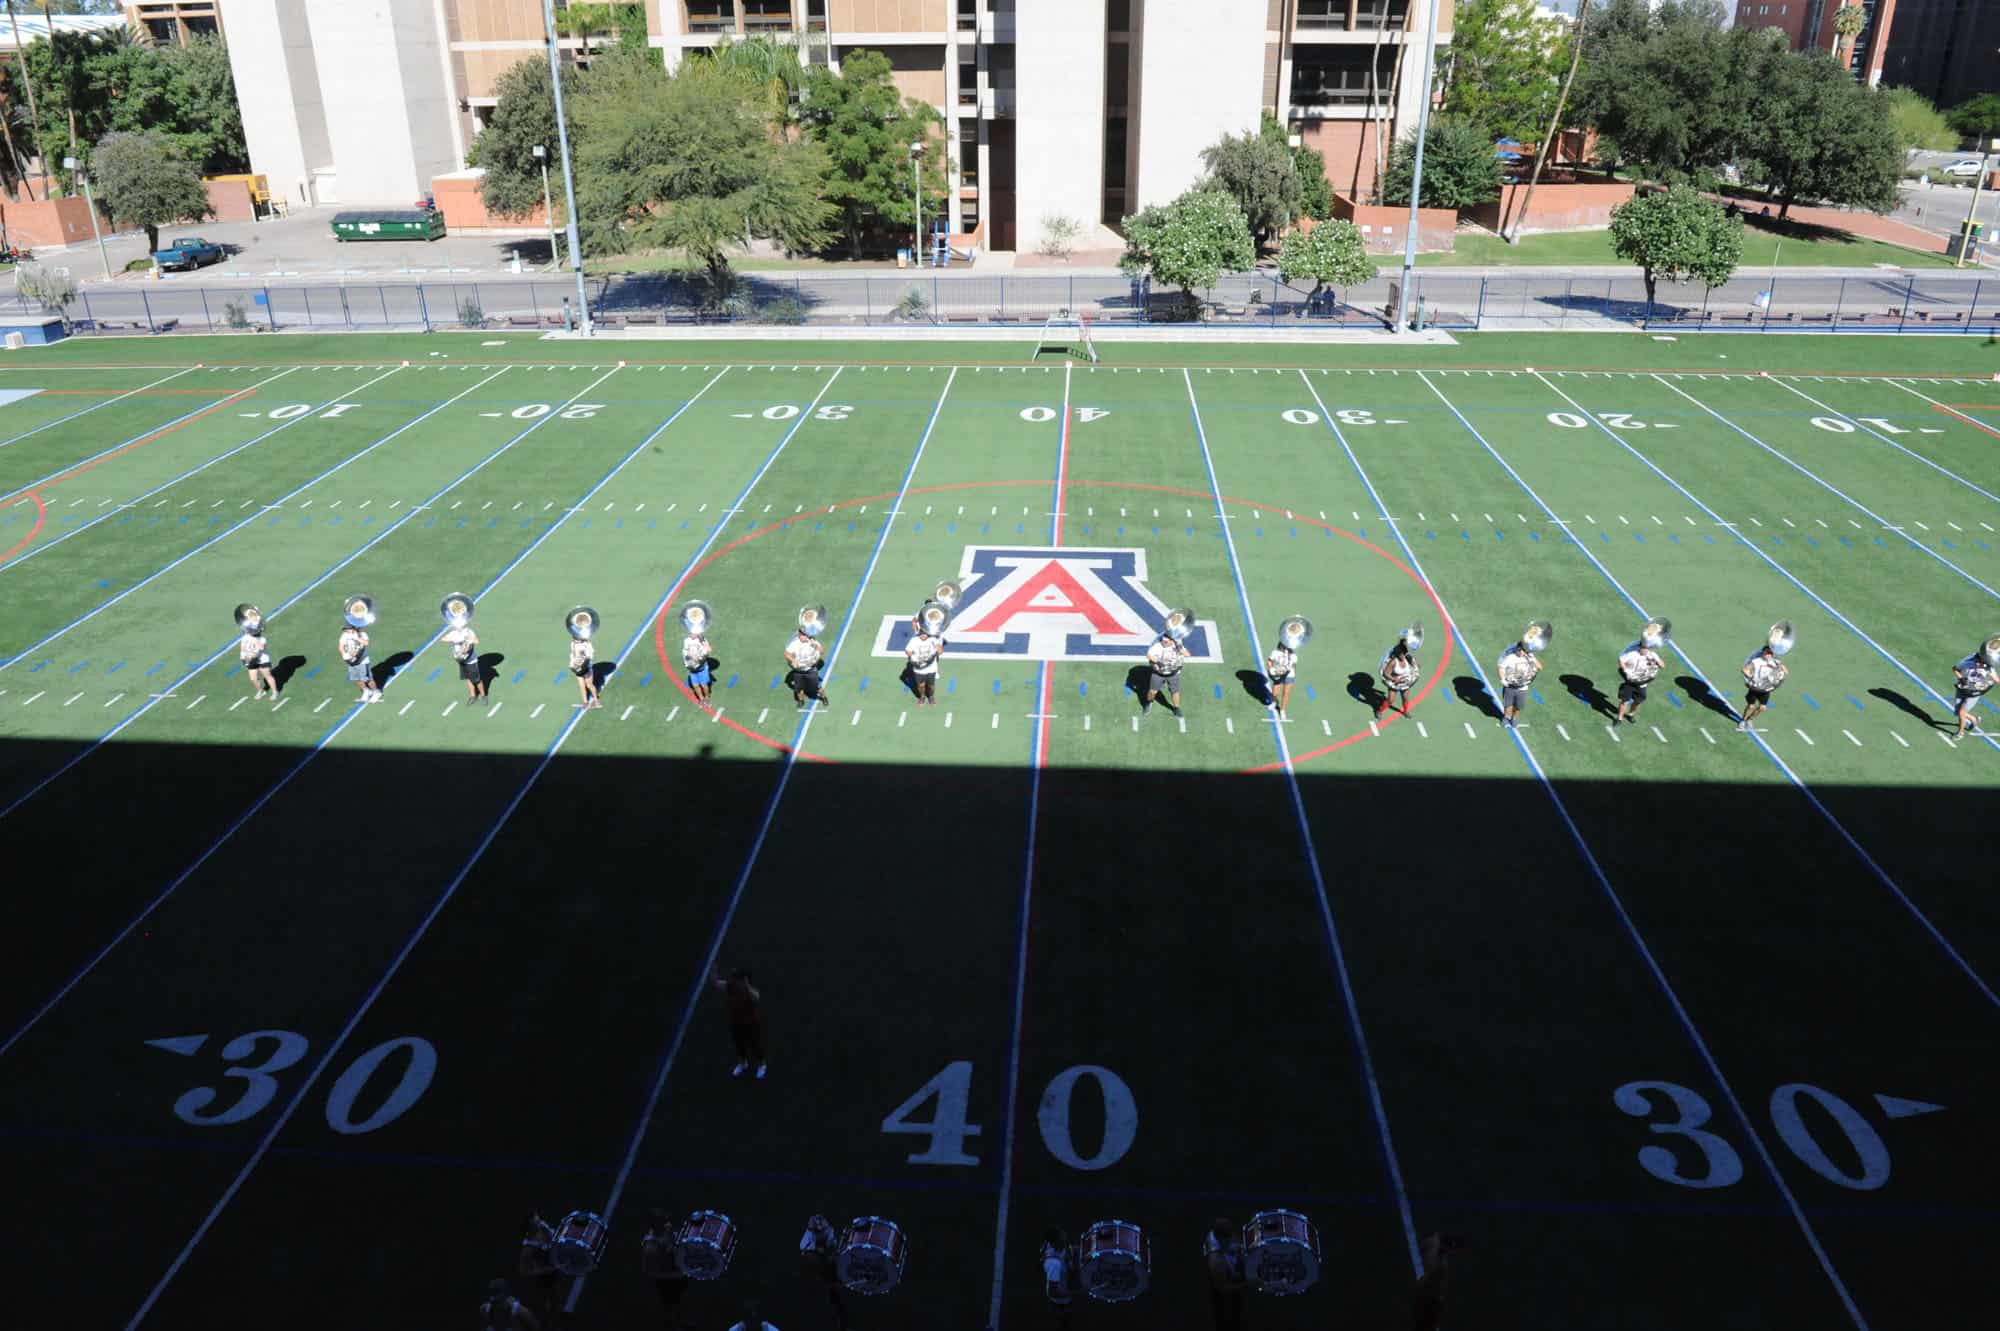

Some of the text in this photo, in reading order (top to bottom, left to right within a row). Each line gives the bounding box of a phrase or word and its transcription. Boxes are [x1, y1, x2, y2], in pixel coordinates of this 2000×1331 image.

[871, 545, 1224, 663] A
[173, 1029, 438, 1135] 30
[881, 1060, 1138, 1170] 40
[1613, 1080, 1891, 1190] 30
